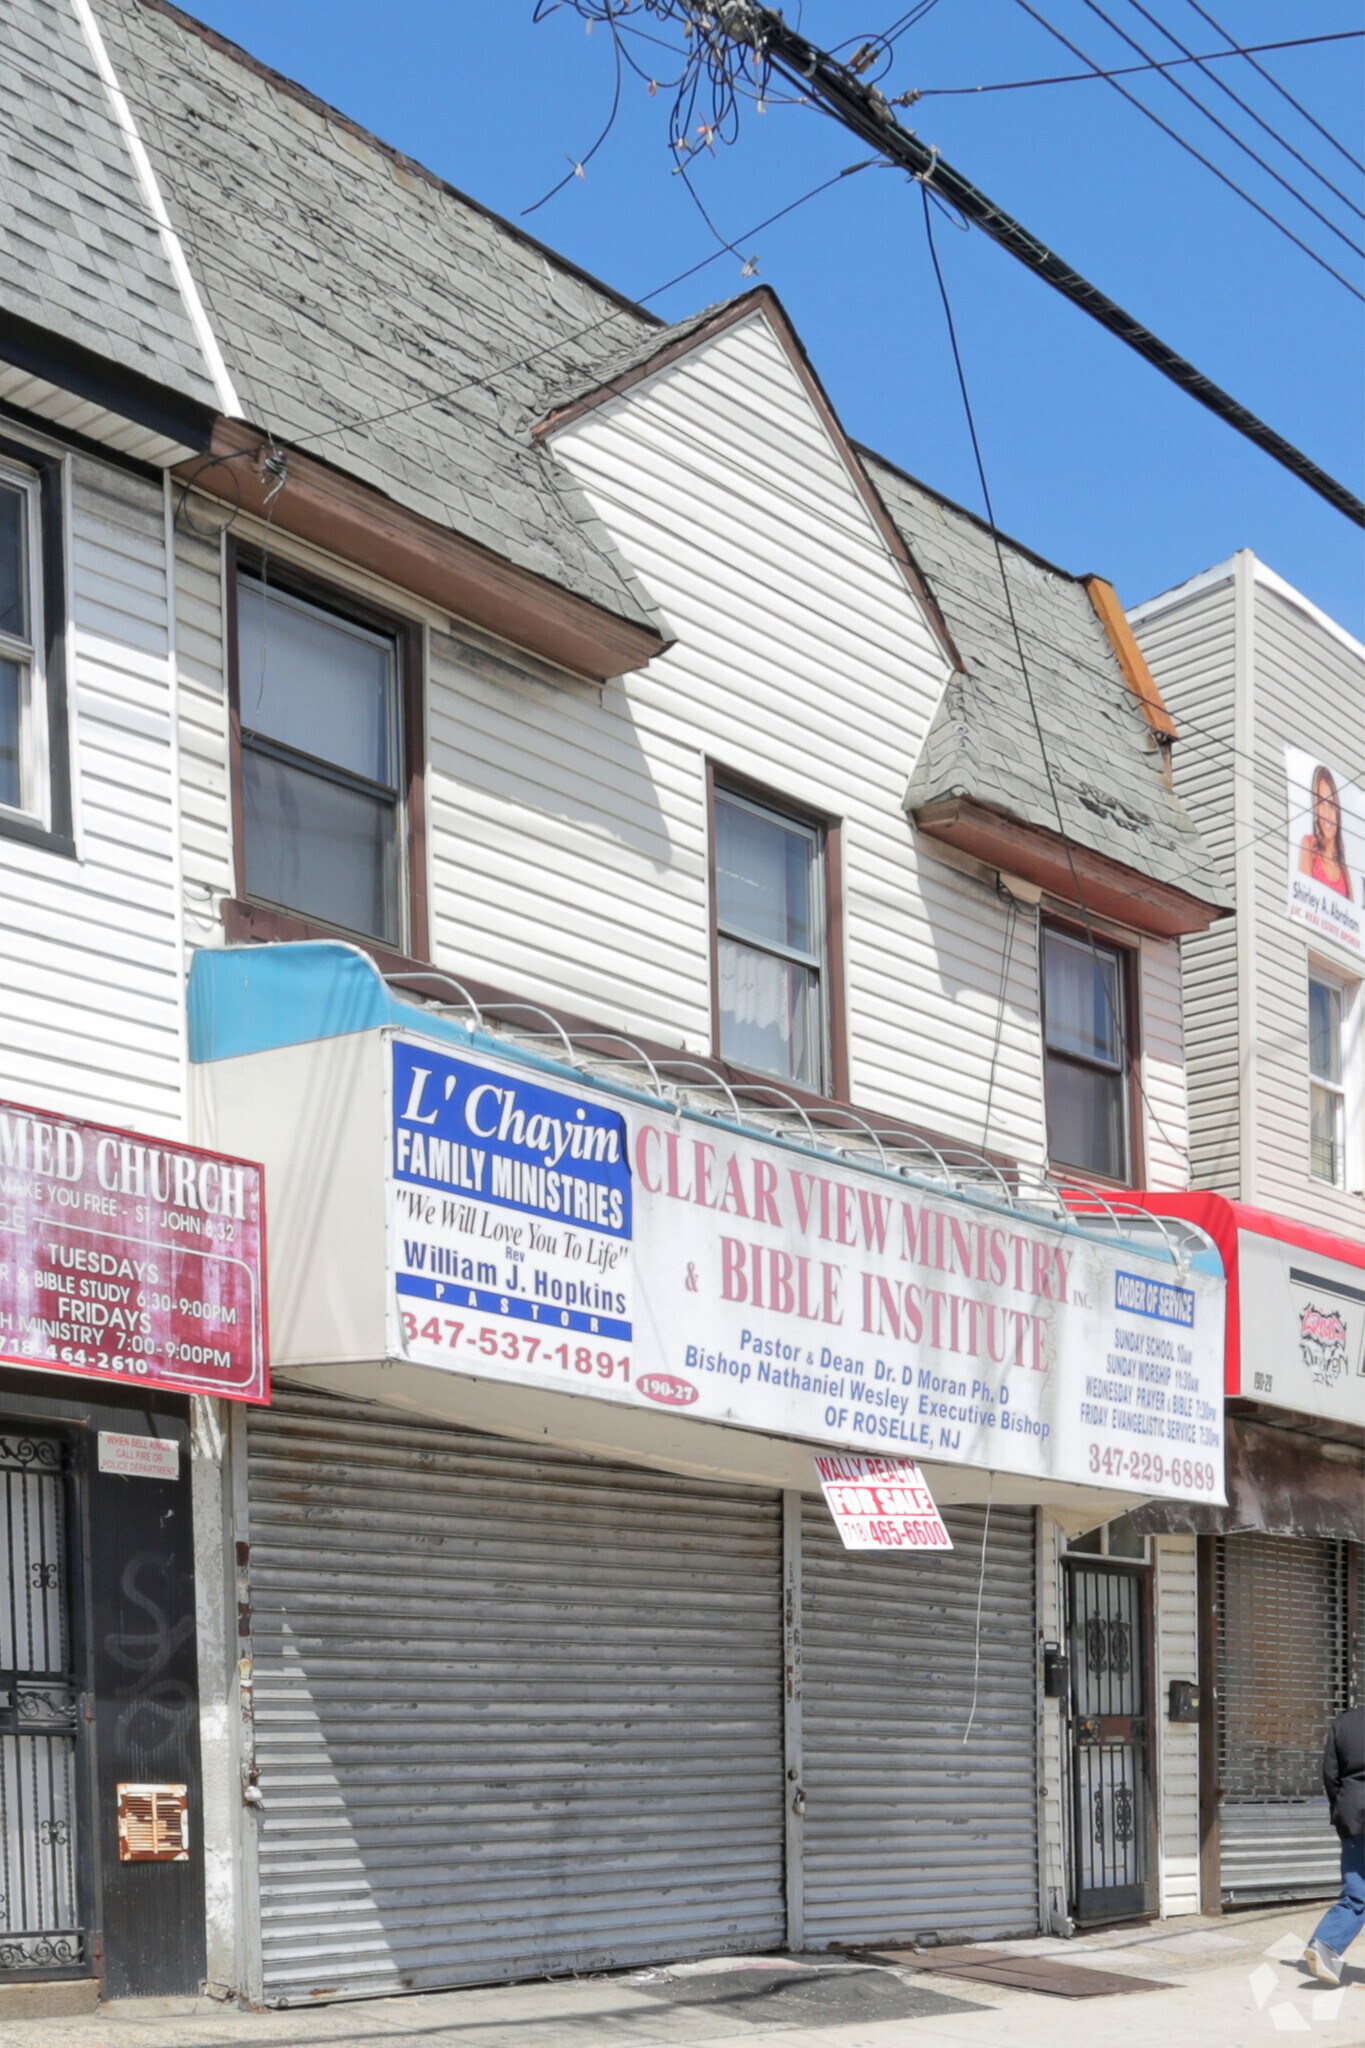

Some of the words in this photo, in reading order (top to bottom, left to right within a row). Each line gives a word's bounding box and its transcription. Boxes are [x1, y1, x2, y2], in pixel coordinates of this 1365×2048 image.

[464, 1083, 620, 1167] Chayim
[97, 1138, 246, 1221] CHURCH
[397, 1127, 486, 1191] FAMILY
[491, 1155, 624, 1230] MINISTRIES
[47, 1184, 80, 1208] YOU
[84, 1193, 117, 1217] FREE
[160, 1210, 200, 1234] JOHN
[636, 1125, 783, 1228] CLEAR
[788, 1169, 893, 1256] VIEW
[900, 1202, 1073, 1304] MINISTRY
[1073, 1290, 1093, 1310] INC.
[396, 1189, 435, 1226] "We
[441, 1201, 476, 1235] Will
[480, 1215, 523, 1246] Love
[528, 1223, 557, 1255] You
[563, 1232, 582, 1261] To
[586, 1242, 629, 1275] Life"
[48, 1243, 158, 1284] TUESDAYS
[506, 1246, 525, 1263] Rev
[34, 1270, 75, 1294] BIBLE
[80, 1279, 130, 1304] STUDY
[137, 1290, 236, 1324] 6:30-9:00PM
[404, 1239, 496, 1287] William
[506, 1264, 526, 1293] J.
[534, 1270, 626, 1315] Hopkins
[59, 1296, 151, 1334] FRIDAYS
[685, 1261, 698, 1292] &
[719, 1235, 843, 1326] BIBLE
[860, 1272, 1049, 1372] INSTITUTE
[1117, 1276, 1146, 1310] ORDER
[1148, 1285, 1159, 1313] OF
[1159, 1288, 1193, 1324] SERVICE
[19, 1315, 104, 1346] MINISTRY
[116, 1332, 231, 1368] 7:00-9:00PM
[401, 1311, 630, 1383] 347-537-1891
[1115, 1328, 1144, 1354] SUNDAY
[1146, 1336, 1175, 1362] SCHOOL
[741, 1329, 800, 1361] Pastor
[807, 1352, 814, 1365] &
[820, 1347, 864, 1375] Dean
[875, 1360, 896, 1383] Dr.
[902, 1366, 912, 1386] D
[918, 1369, 966, 1396] Moran
[972, 1380, 994, 1403] Ph.
[1000, 1386, 1009, 1405] D
[1107, 1354, 1137, 1379] SUNDAY
[1139, 1361, 1171, 1386] WORSHIP
[1254, 1371, 1272, 1392] 190-29
[641, 1378, 694, 1401] 190-27
[685, 1345, 751, 1383] Bishop
[757, 1361, 844, 1398] Nathaniel
[850, 1380, 908, 1416] Wesley
[919, 1395, 996, 1427] Executive
[1001, 1411, 1049, 1441] Bishop
[1086, 1376, 1133, 1405] WEDNESDAY
[1137, 1387, 1165, 1412] PRAYER
[1173, 1395, 1192, 1417] BIBLE
[107, 1435, 129, 1447] WHEN
[131, 1438, 147, 1449] BELL
[150, 1440, 170, 1452] RINGS
[825, 1406, 848, 1428] OF
[853, 1411, 934, 1450] ROSELLE,
[940, 1428, 960, 1449] NJ
[1081, 1402, 1108, 1427] FRIDAY
[1112, 1408, 1165, 1437] EVANGELISTIC
[1167, 1419, 1196, 1443] SERVICE
[102, 1460, 129, 1471] POLICE
[130, 1462, 175, 1475] DEPARTMENT
[116, 1448, 134, 1459] CALL
[136, 1451, 150, 1462] FIRE
[153, 1453, 163, 1462] OR
[815, 1457, 864, 1482] WALLY
[866, 1459, 919, 1483] REALTY
[1089, 1444, 1214, 1491] 347-229-6889
[828, 1487, 879, 1514] FOR
[876, 1488, 934, 1515] SALE
[870, 1520, 947, 1546] 465-6600
